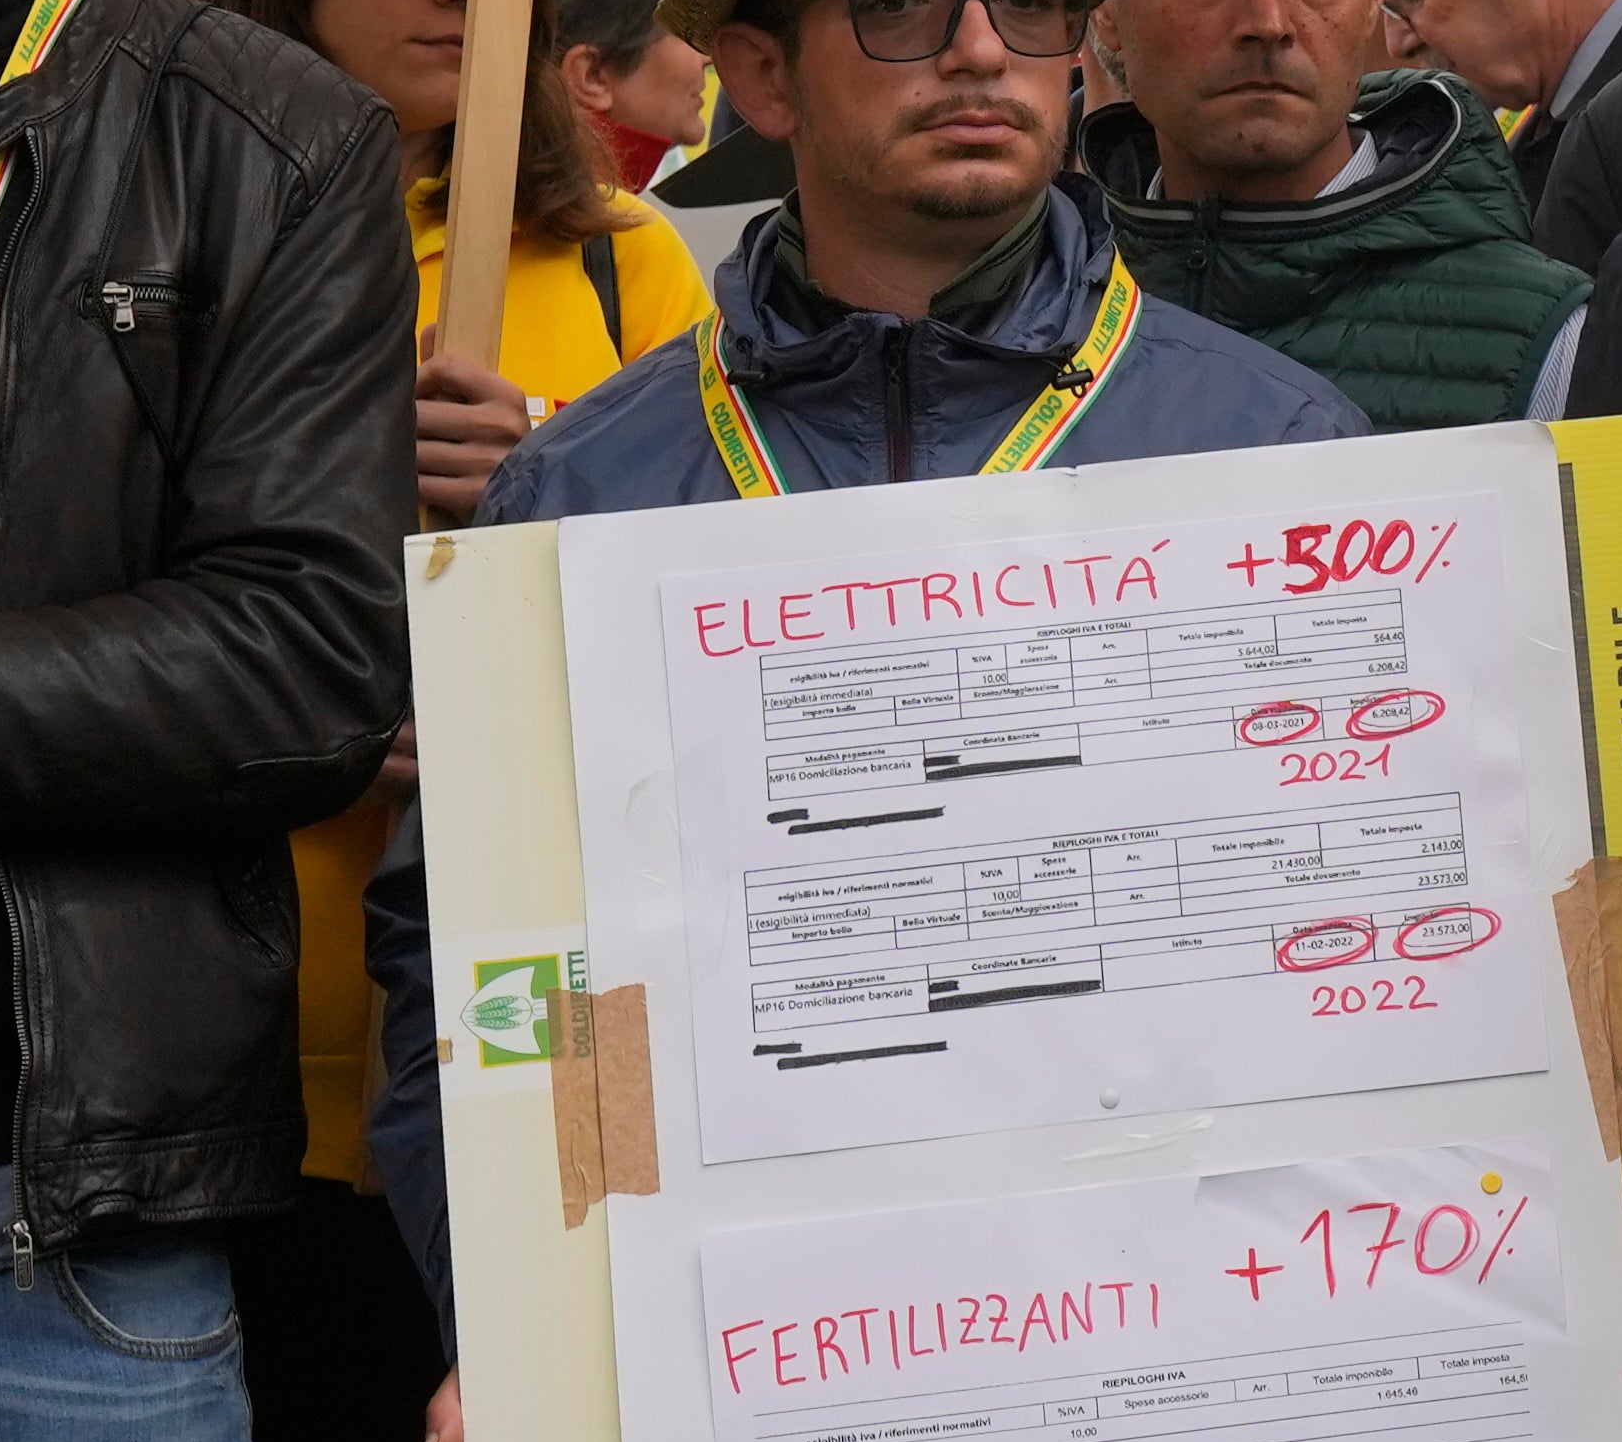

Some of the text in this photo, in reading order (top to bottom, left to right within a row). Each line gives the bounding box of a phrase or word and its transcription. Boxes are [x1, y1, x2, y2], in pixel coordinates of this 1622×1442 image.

[1090, 278, 1128, 357] COLDIRETTI
[710, 401, 759, 490] COLDIRETTI
[695, 516, 1458, 657] ELETTRICITÁ +500%
[1374, 631, 1404, 642] 564,40
[1368, 661, 1406, 673] 6.208,42
[982, 673, 1007, 683] 10,00
[820, 687, 873, 700] immediata)
[1252, 717, 1304, 731] 08-03-2021
[870, 759, 911, 772] bancaria
[1279, 744, 1390, 786] 2021
[1421, 840, 1463, 853] 2.143,00
[1271, 856, 1321, 870] 21.430,00
[1418, 872, 1466, 886] 23.573,00
[992, 889, 1020, 901] 10,00
[756, 907, 871, 931] (esigibilità immediata)
[1422, 923, 1470, 938] 23.573,00
[1295, 936, 1353, 952] 11-02-2022
[755, 987, 913, 1014] MP16 Domiciliazione bancaria
[1312, 976, 1438, 1016] 2022
[720, 1196, 1533, 1394] FERTILIZZANTI +170%
[1440, 1357, 1470, 1370] Totale
[1102, 1370, 1186, 1388] RIEPILOGHI IVA
[1058, 1406, 1085, 1418] %IVA
[861, 1432, 876, 1442] iva
[885, 1423, 939, 1440] riferimenti
[943, 1417, 991, 1433] normativi
[1070, 1427, 1097, 1440] 10,00
